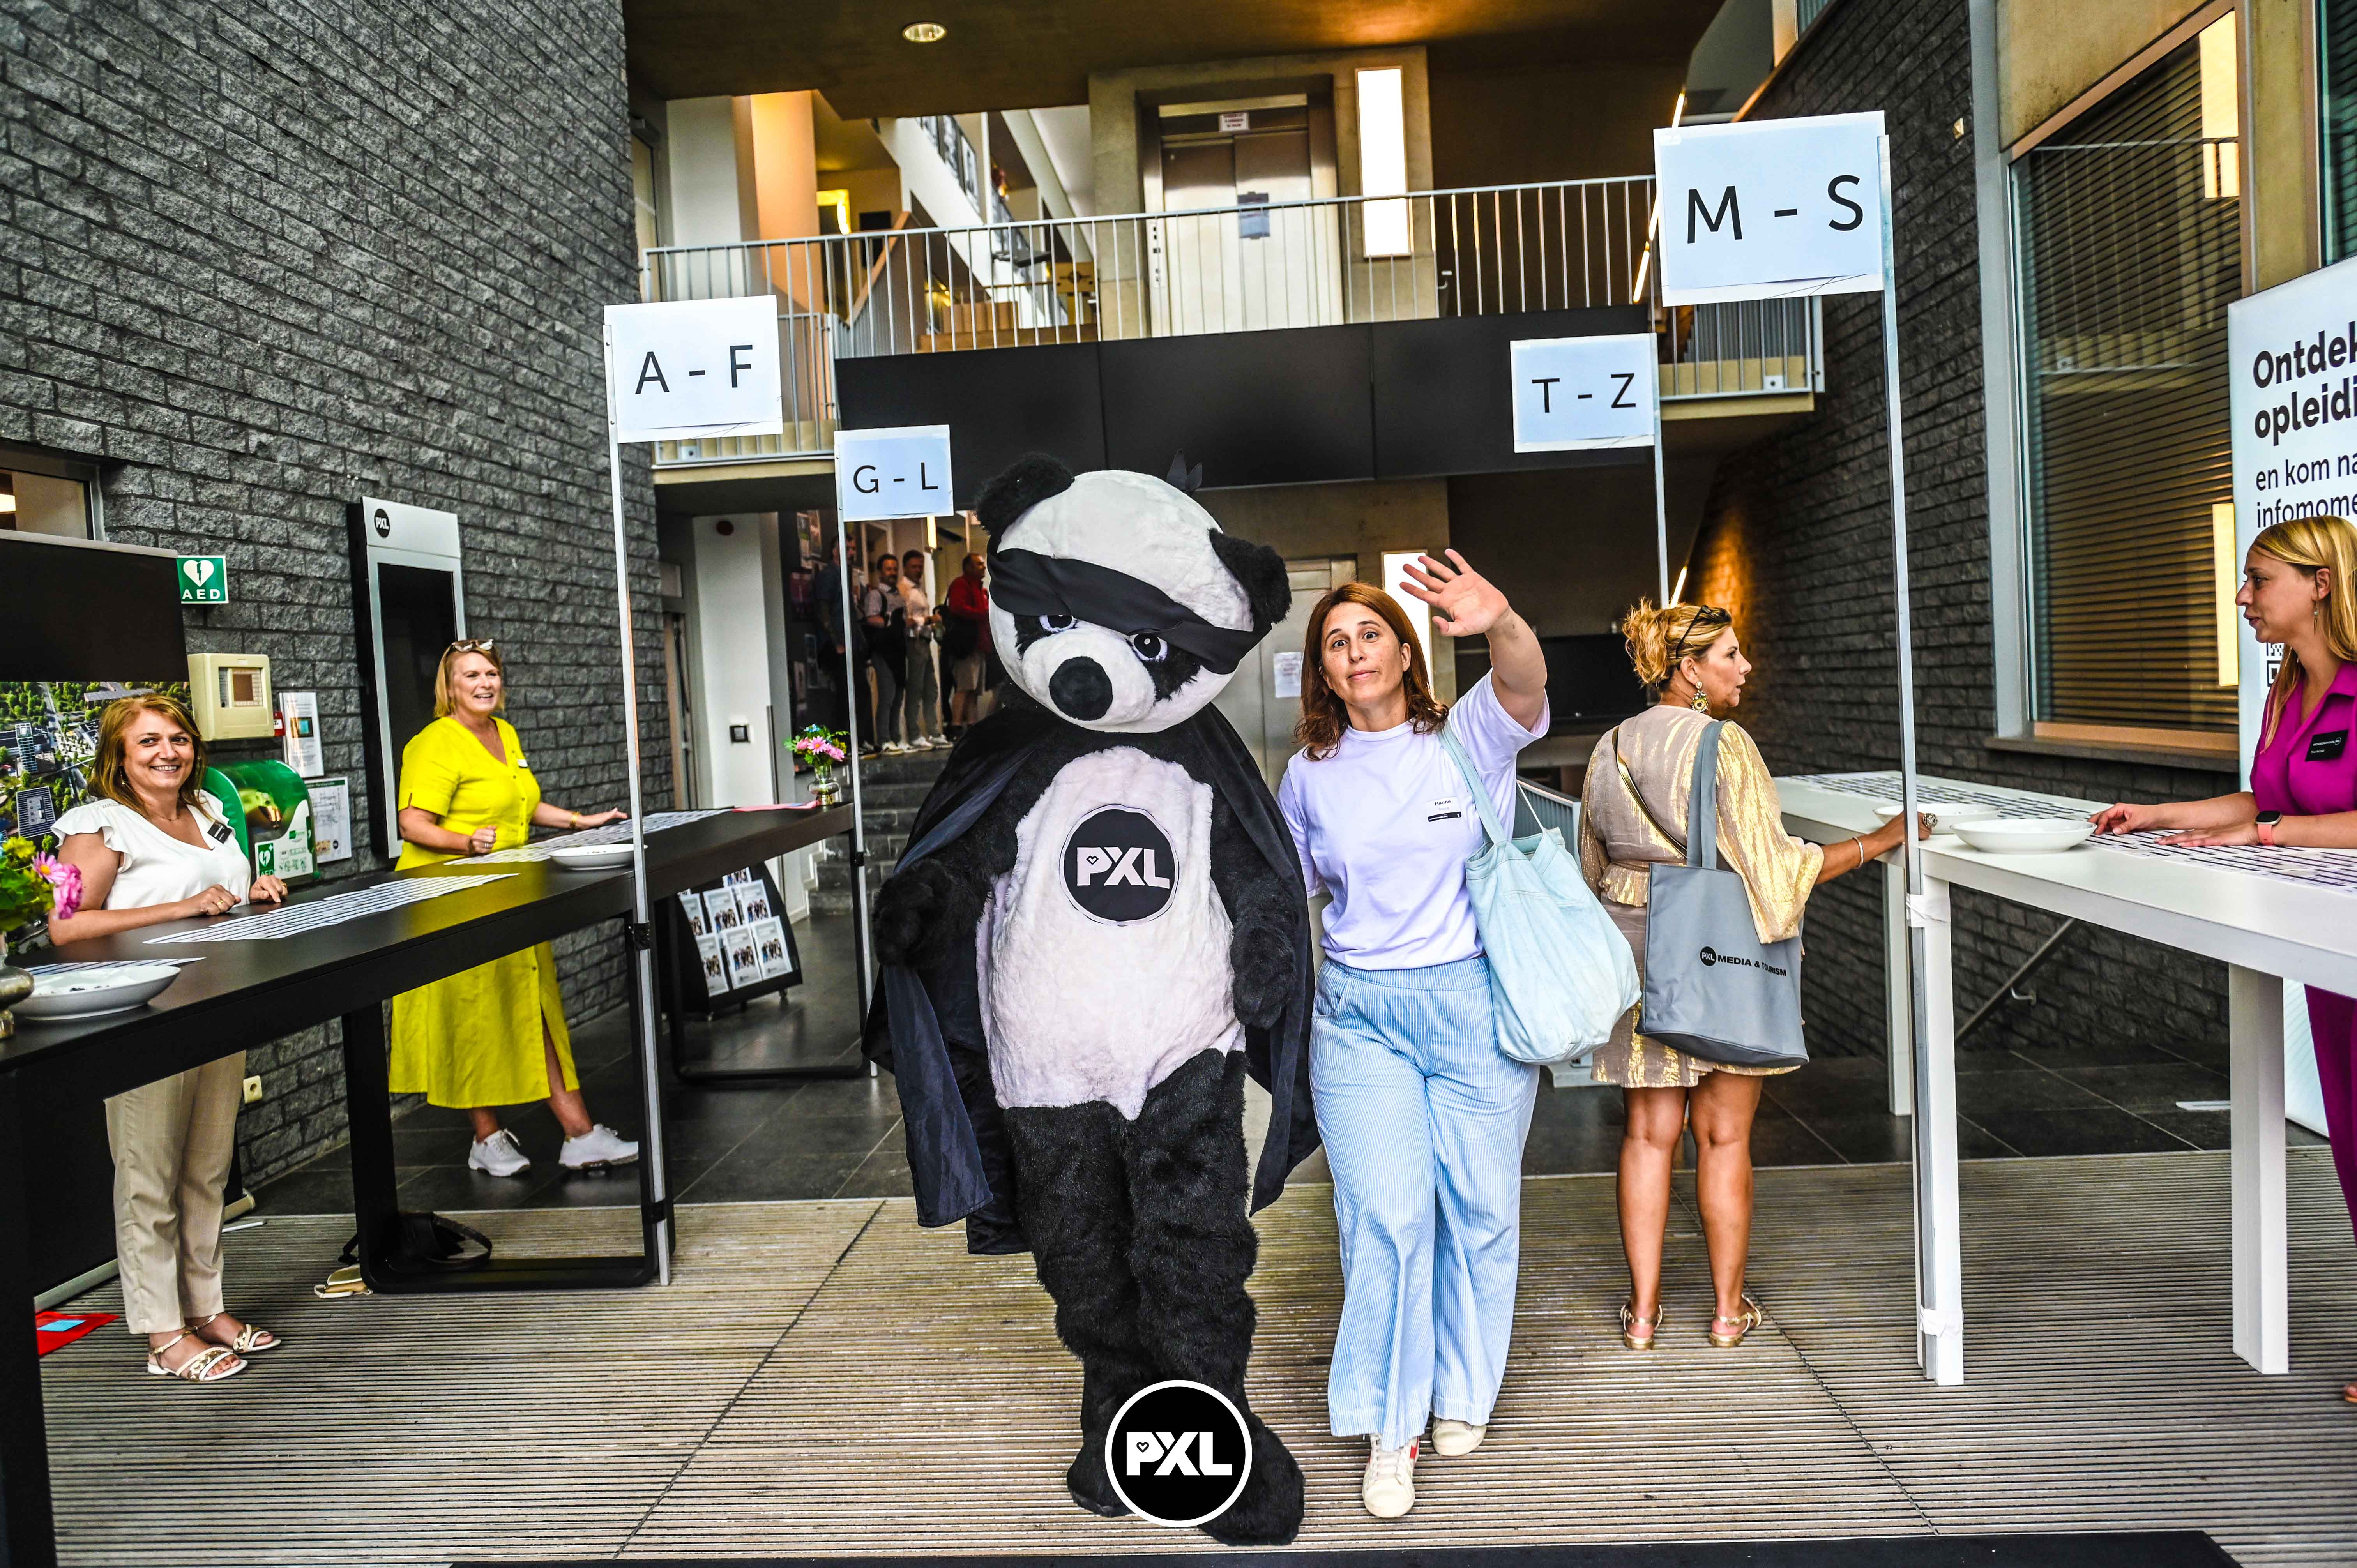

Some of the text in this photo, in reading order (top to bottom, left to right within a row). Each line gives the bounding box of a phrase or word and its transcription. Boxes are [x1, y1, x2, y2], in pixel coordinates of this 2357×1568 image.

[1687, 174, 1864, 244] M - S
[635, 351, 670, 394] A
[730, 344, 753, 388] F
[1532, 378, 1560, 413] T
[1611, 373, 1636, 409] Z
[853, 465, 879, 493] G
[921, 462, 938, 490] L
[2256, 468, 2279, 491] en
[2285, 459, 2330, 486] kom
[375, 516, 389, 530] PXL
[182, 589, 221, 599] AED
[1077, 846, 1170, 890] PXL
[1701, 952, 1715, 961] PXL
[1718, 955, 1752, 966] MEDIA
[1761, 962, 1787, 976] TOURISM
